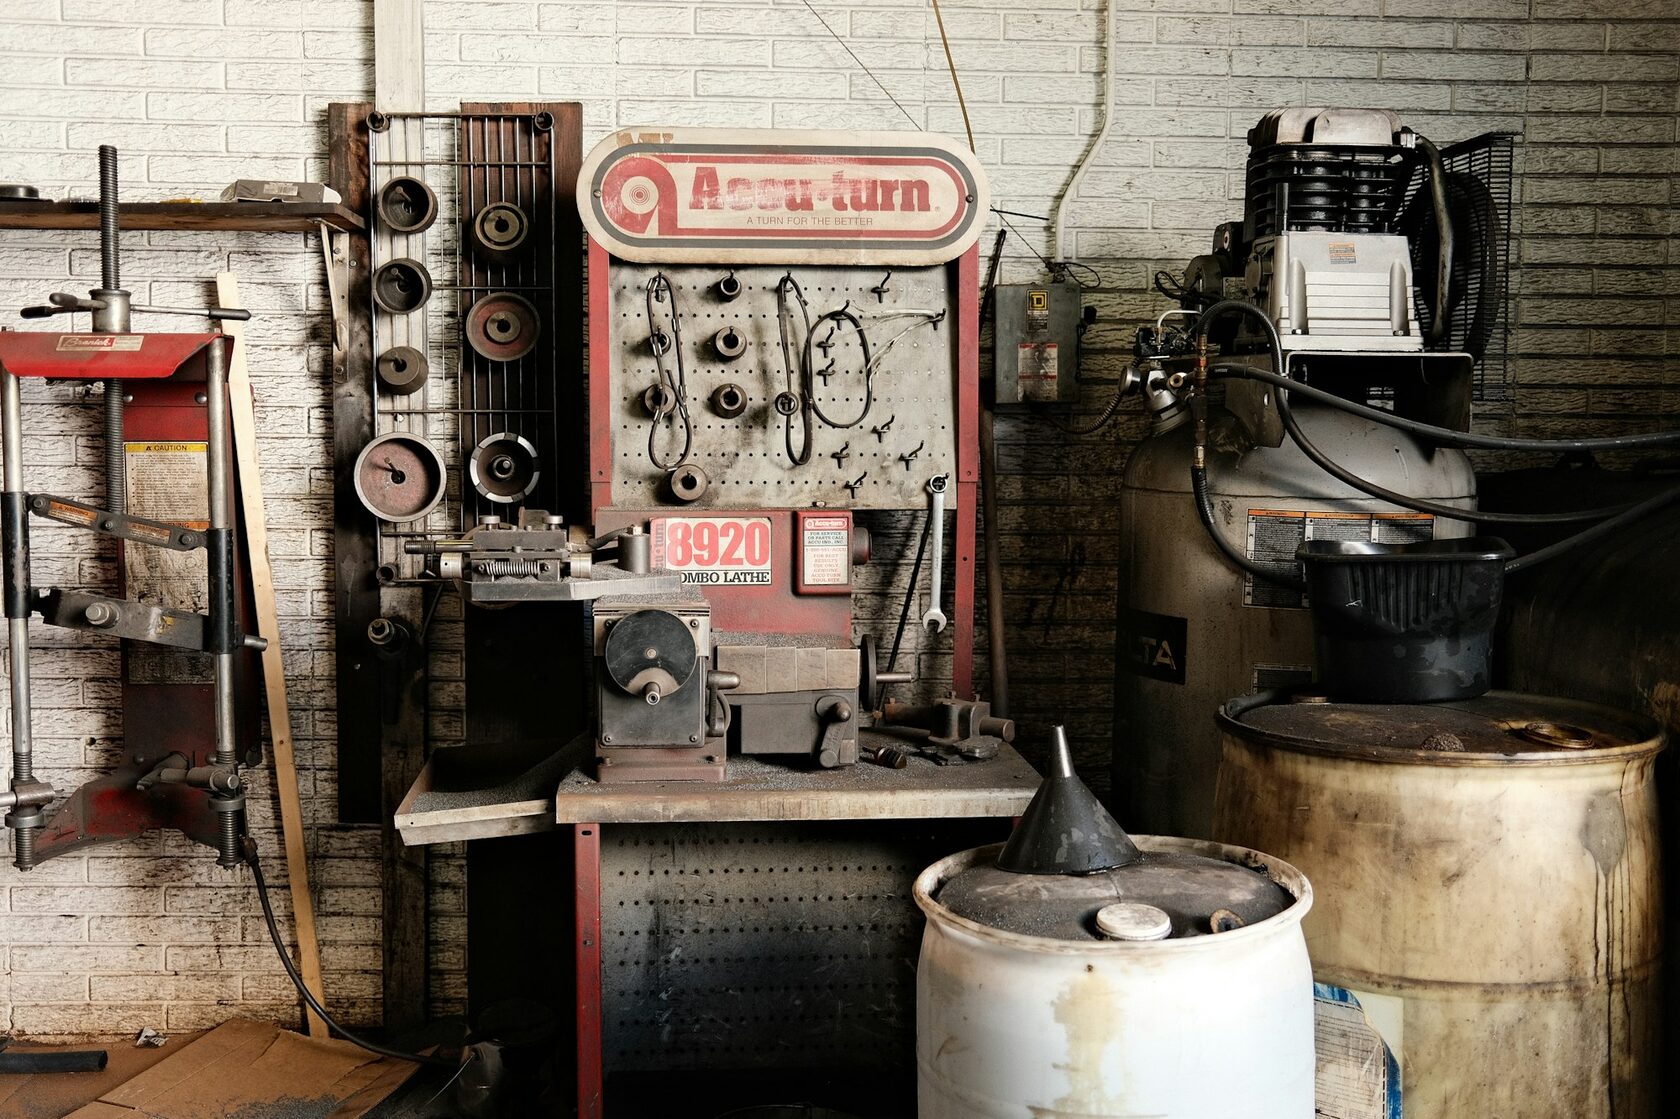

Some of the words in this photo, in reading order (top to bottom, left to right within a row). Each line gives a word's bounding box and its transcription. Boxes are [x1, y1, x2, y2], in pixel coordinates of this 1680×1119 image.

[746, 216, 754, 225] A
[756, 216, 784, 225] TURN
[787, 217, 808, 225] FOR
[812, 217, 832, 225] THE
[834, 217, 873, 226] BETTER
[667, 521, 770, 567] 8920
[681, 571, 720, 584] OMBO
[723, 571, 770, 583] LATHE
